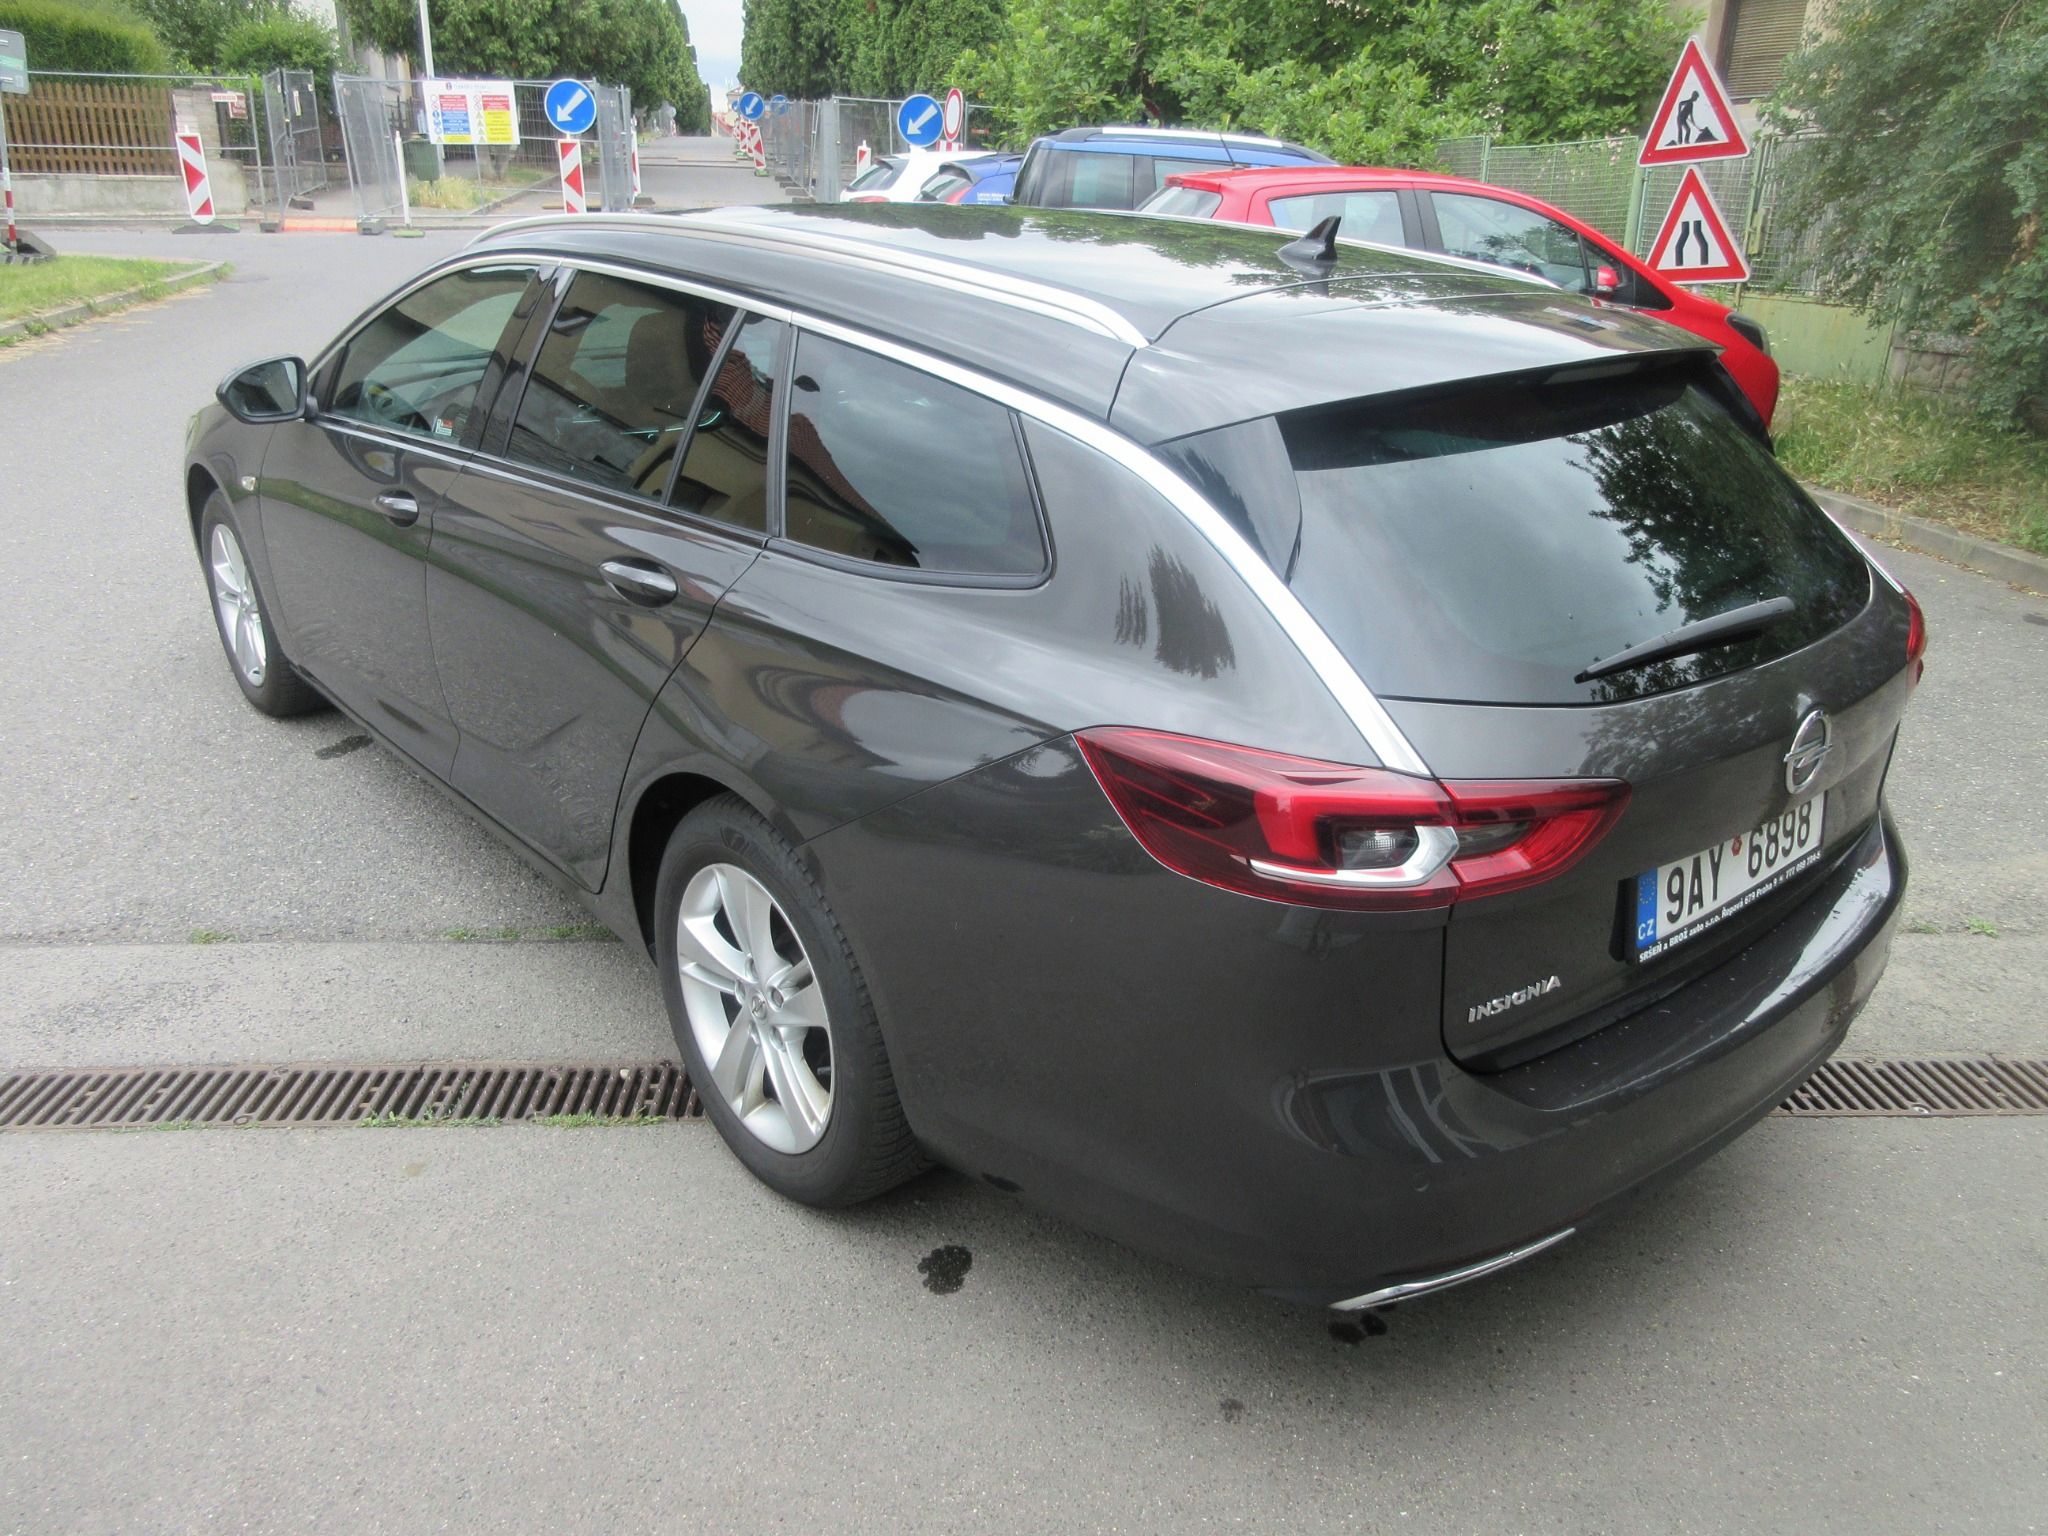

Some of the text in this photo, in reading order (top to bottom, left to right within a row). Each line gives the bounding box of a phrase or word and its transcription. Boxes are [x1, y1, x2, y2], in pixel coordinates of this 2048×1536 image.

[1666, 800, 1812, 924] 9AY 6898
[1638, 918, 1655, 940] CZ
[1689, 922, 1704, 936] auto
[1756, 882, 1773, 897] Praha
[1468, 975, 1561, 1023] INSIGNIA
